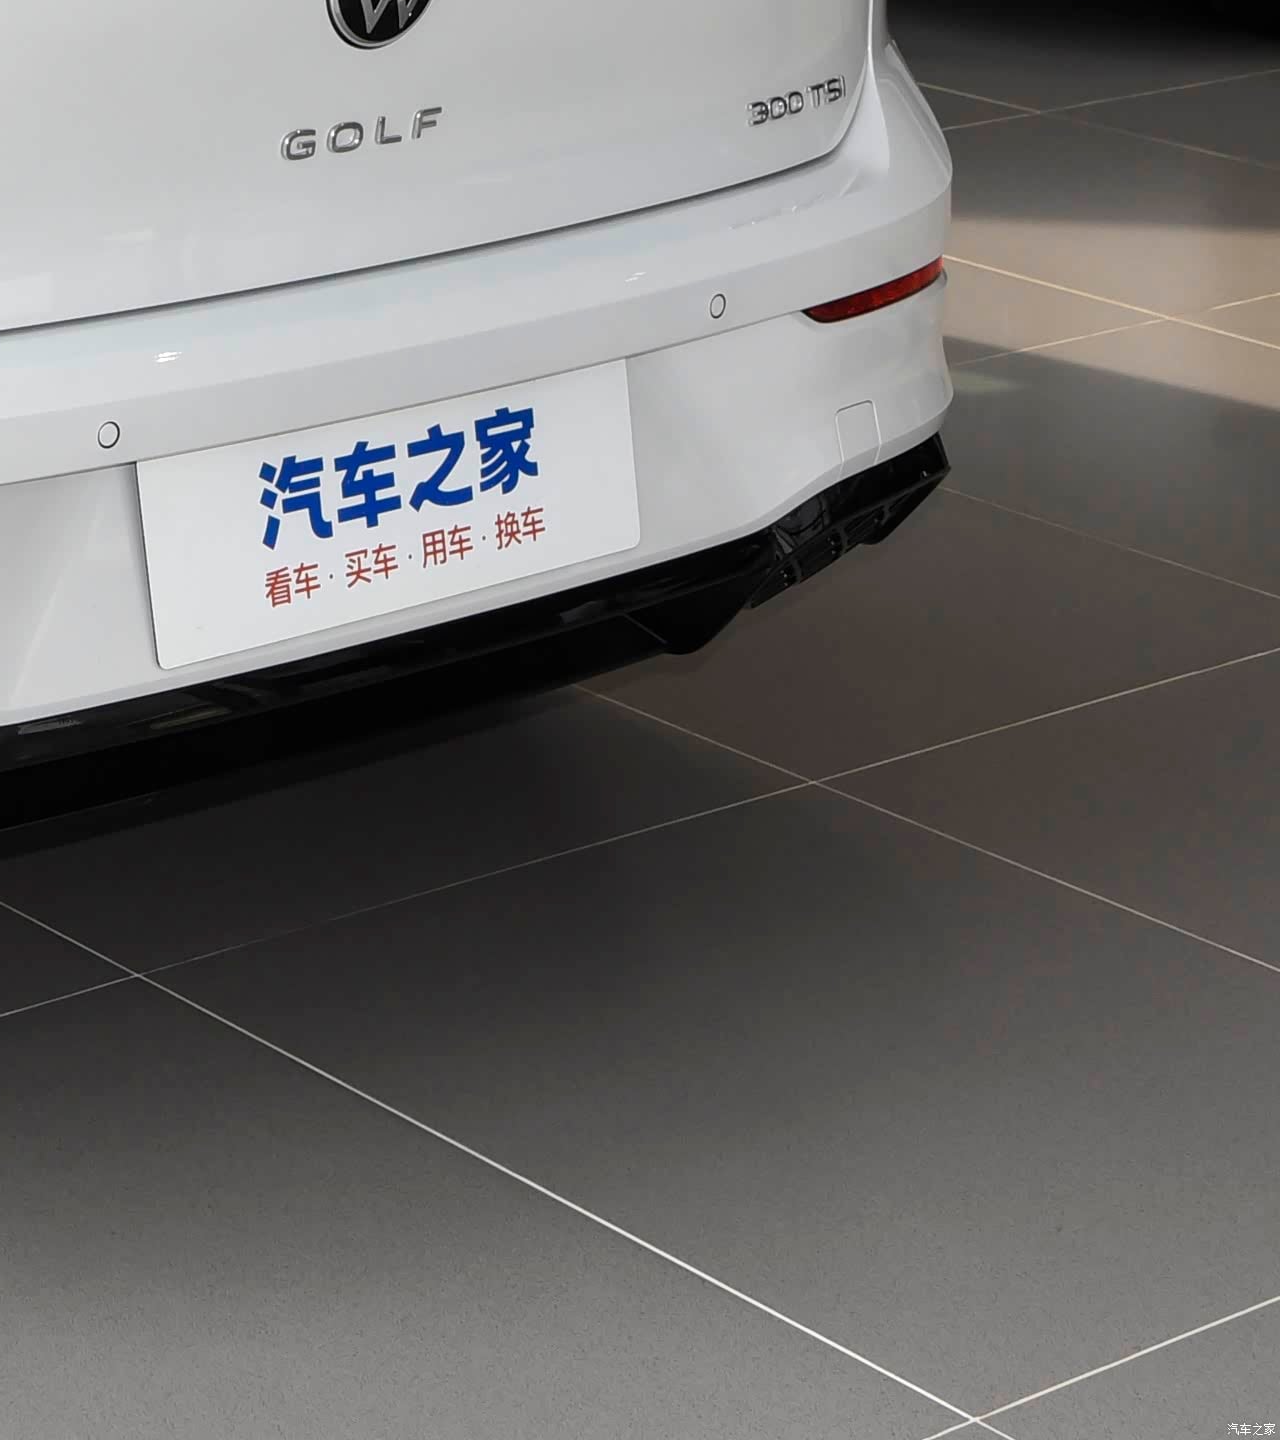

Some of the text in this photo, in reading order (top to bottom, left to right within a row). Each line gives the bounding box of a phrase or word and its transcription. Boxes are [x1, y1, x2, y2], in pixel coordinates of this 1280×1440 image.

[746, 75, 846, 128] 300 TSI
[280, 105, 443, 161] GOLF
[258, 406, 539, 551] 汽车之家
